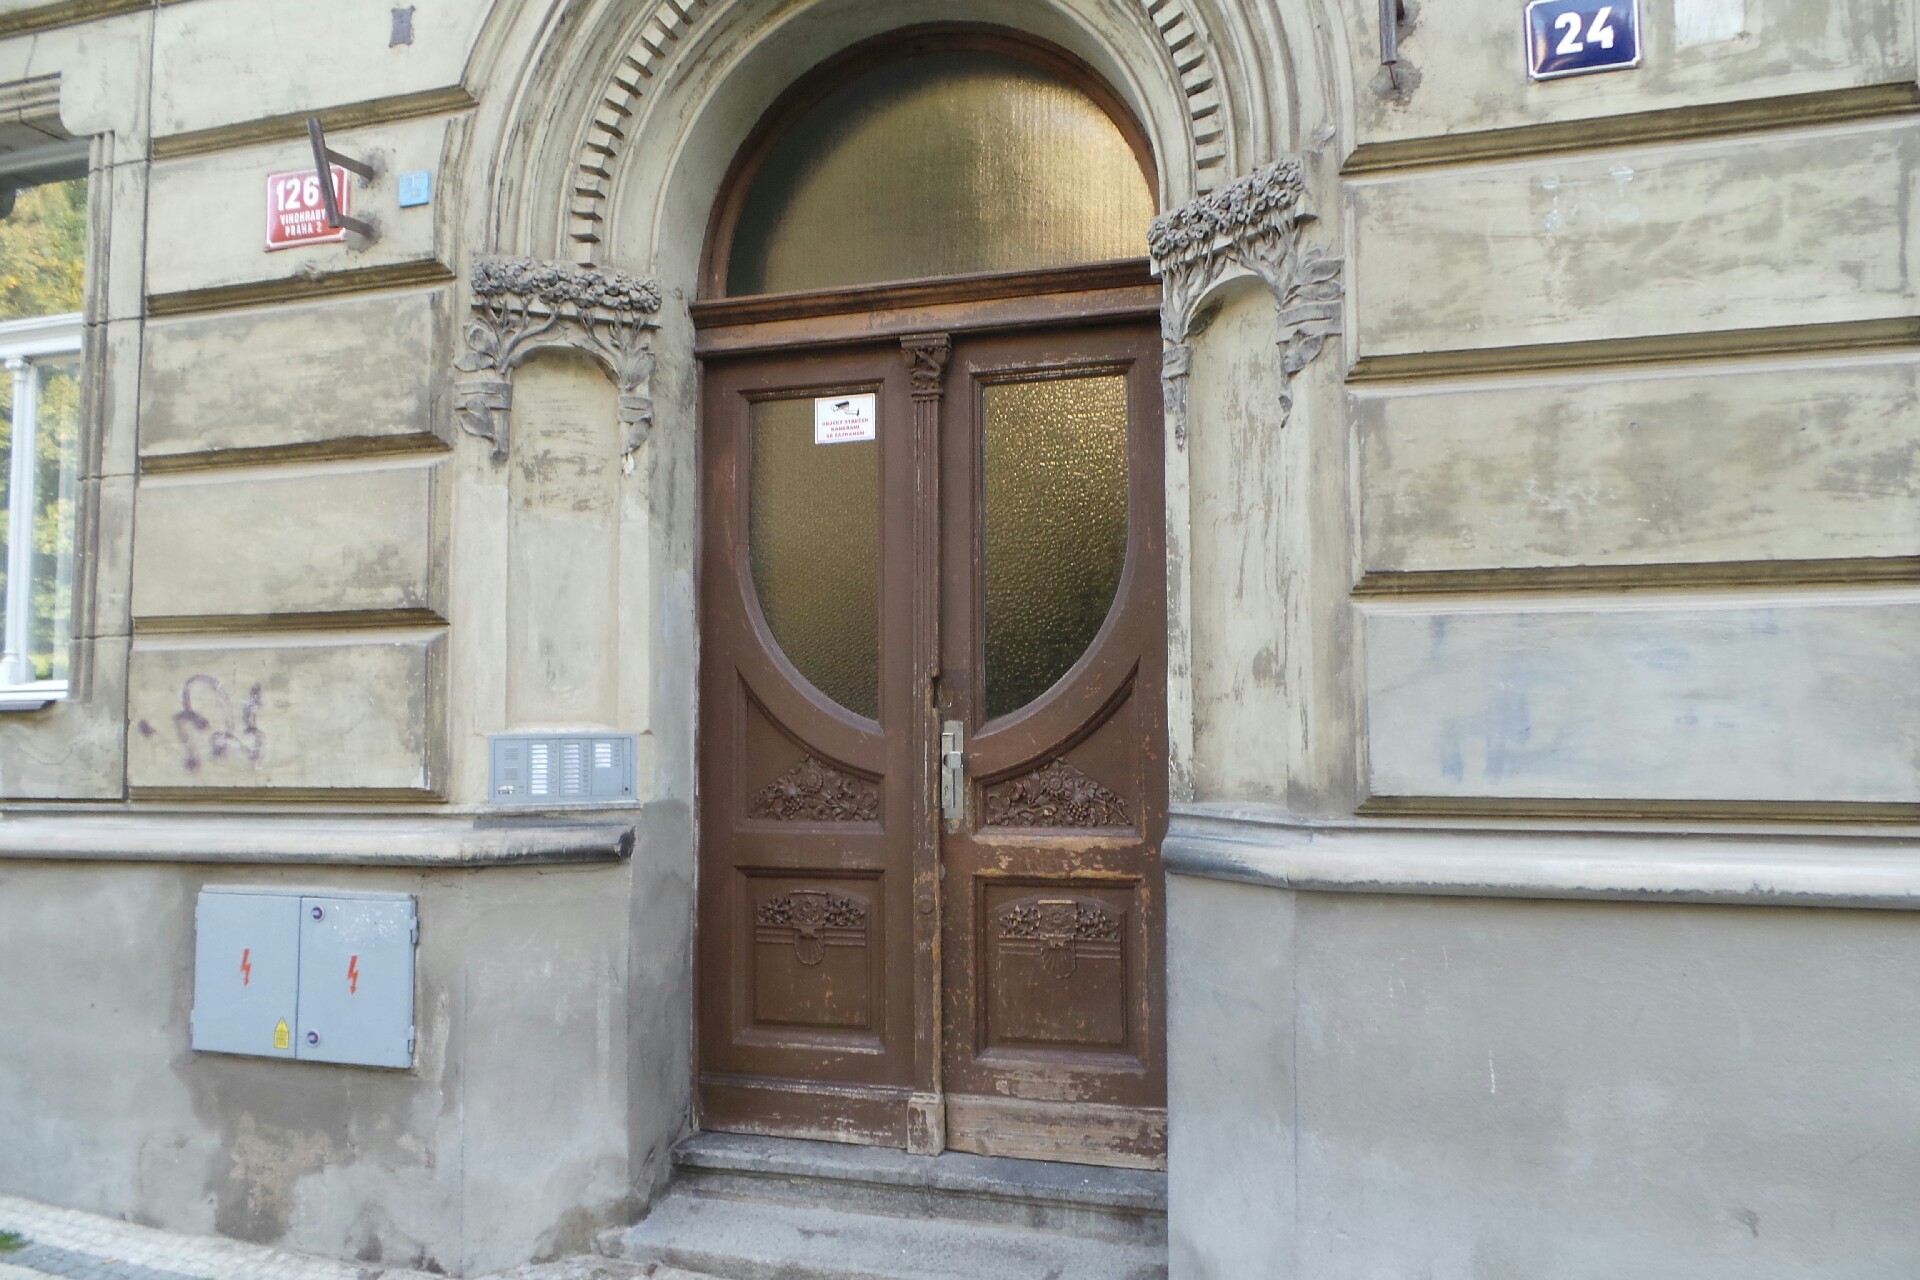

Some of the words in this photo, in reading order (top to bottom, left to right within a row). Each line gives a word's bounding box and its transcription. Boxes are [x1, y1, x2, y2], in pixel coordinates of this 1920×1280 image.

[1554, 6, 1614, 55] 24
[280, 208, 326, 225] VINOHRADY
[285, 222, 313, 237] PRAHA
[316, 220, 323, 233] 2
